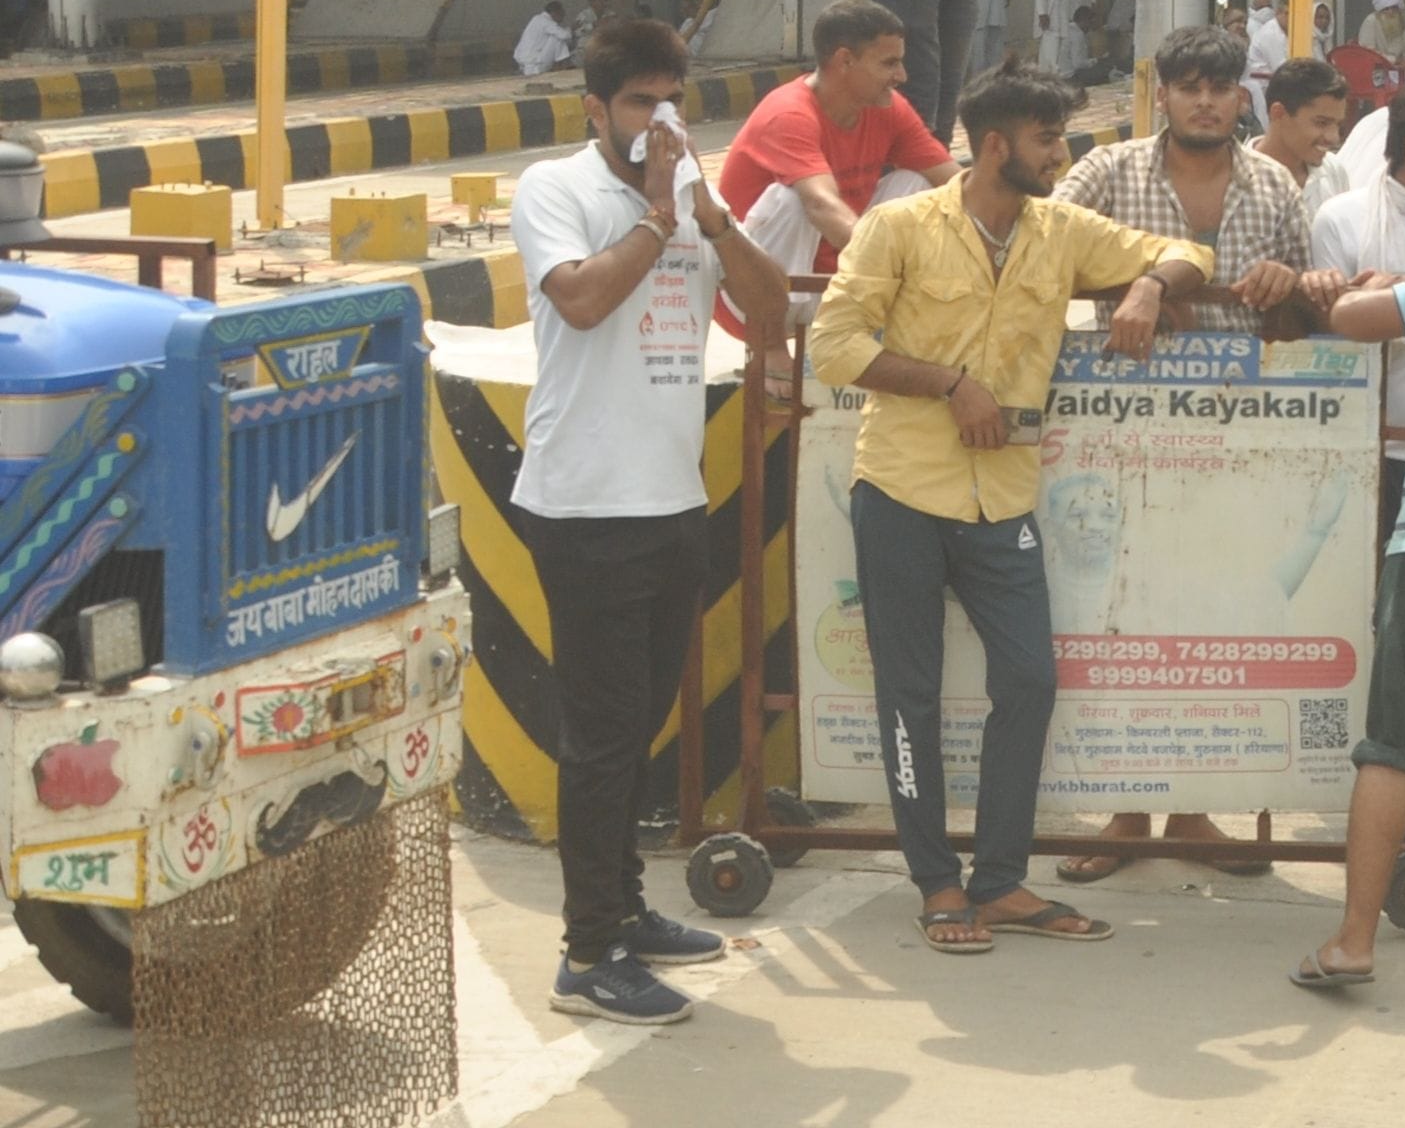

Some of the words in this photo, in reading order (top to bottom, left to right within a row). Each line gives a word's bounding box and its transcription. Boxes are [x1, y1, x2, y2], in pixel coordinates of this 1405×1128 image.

[1064, 335, 1251, 358] HIWAYS
[284, 339, 343, 384] राहुल
[1091, 360, 1138, 378] OF
[1149, 360, 1248, 379] INDIA
[1169, 390, 1342, 425] Kayakalp
[225, 601, 265, 647] जय
[264, 588, 307, 633] बाबा
[1051, 641, 1169, 663] 5299299,
[1176, 641, 1338, 661] 7428299299
[1088, 666, 1247, 685] 9999407501
[42, 850, 119, 892] शुभ
